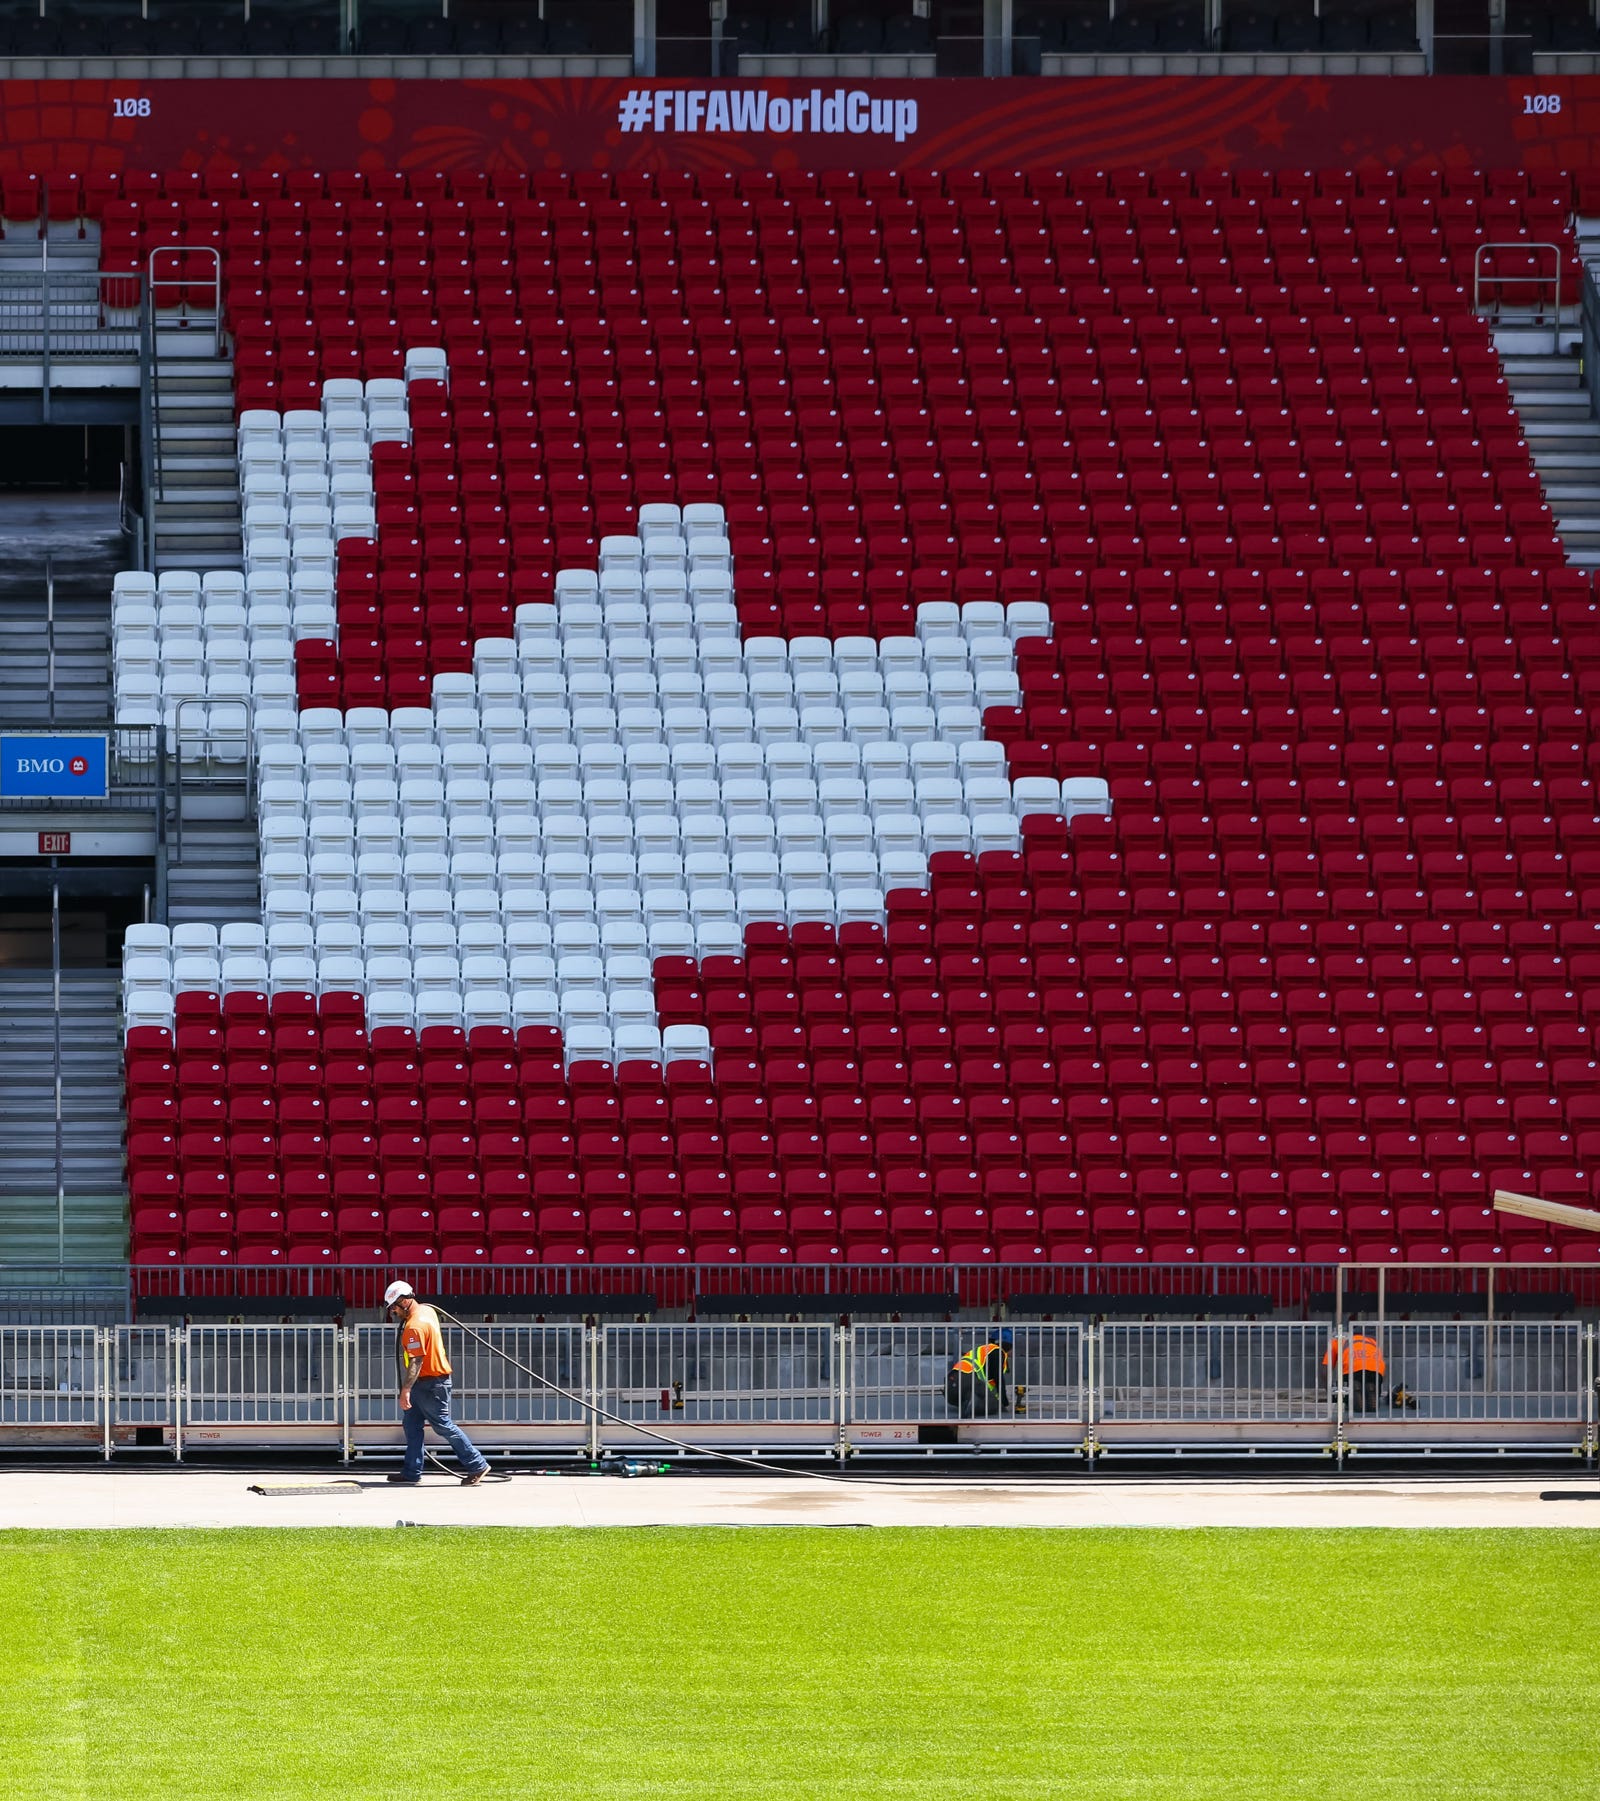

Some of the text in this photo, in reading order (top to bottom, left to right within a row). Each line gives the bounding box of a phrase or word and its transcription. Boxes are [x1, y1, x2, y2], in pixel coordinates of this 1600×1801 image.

[112, 97, 151, 118] 108
[1522, 94, 1562, 115] 108
[618, 88, 918, 143] #FIFAWorldCup
[16, 758, 65, 773] BMO
[43, 834, 67, 852] EXIT
